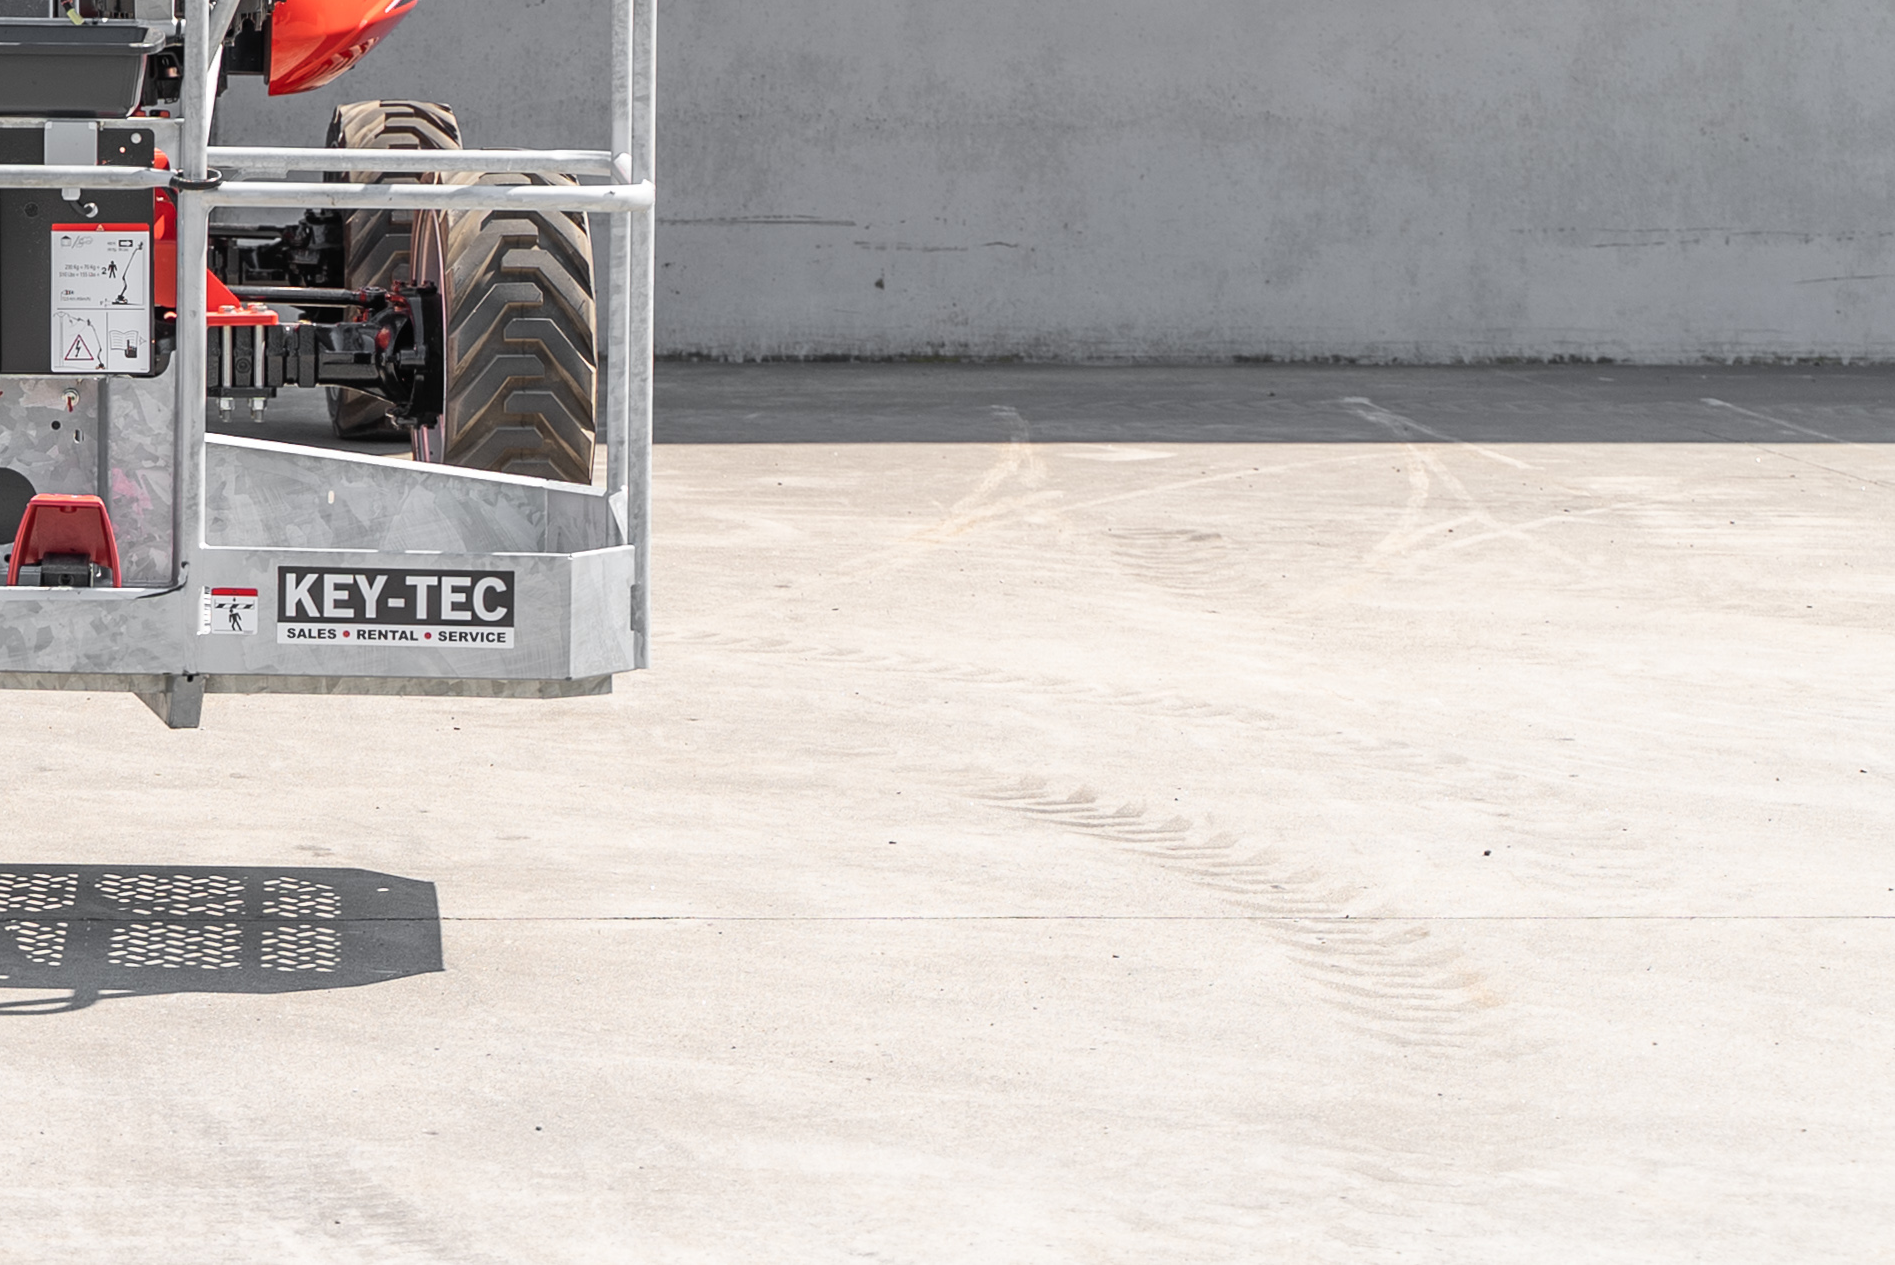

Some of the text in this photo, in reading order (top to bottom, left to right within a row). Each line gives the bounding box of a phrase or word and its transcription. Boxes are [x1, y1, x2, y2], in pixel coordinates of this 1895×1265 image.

[285, 572, 508, 621] KEY-TEC
[286, 627, 506, 643] SALES RENTAL SERVICE
